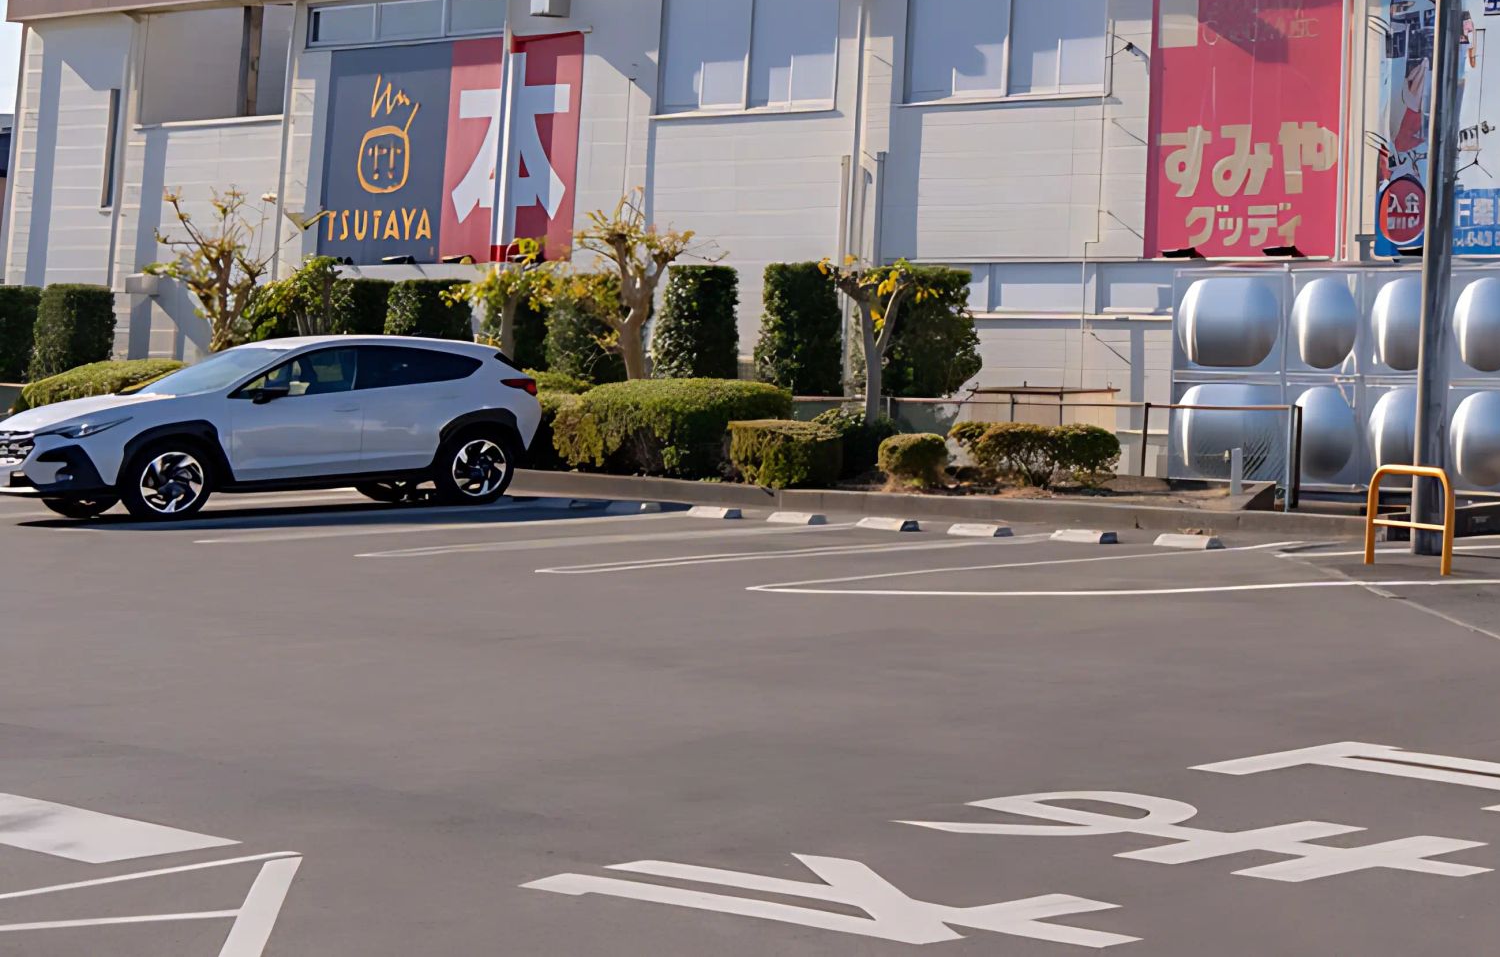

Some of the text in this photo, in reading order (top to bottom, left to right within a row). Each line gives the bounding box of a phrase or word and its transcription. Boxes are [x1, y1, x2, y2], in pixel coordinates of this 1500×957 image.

[452, 53, 570, 223] 本
[1157, 121, 1338, 198] すみや
[327, 207, 432, 242] TSUTAYA
[1186, 203, 1301, 247] グッディ
